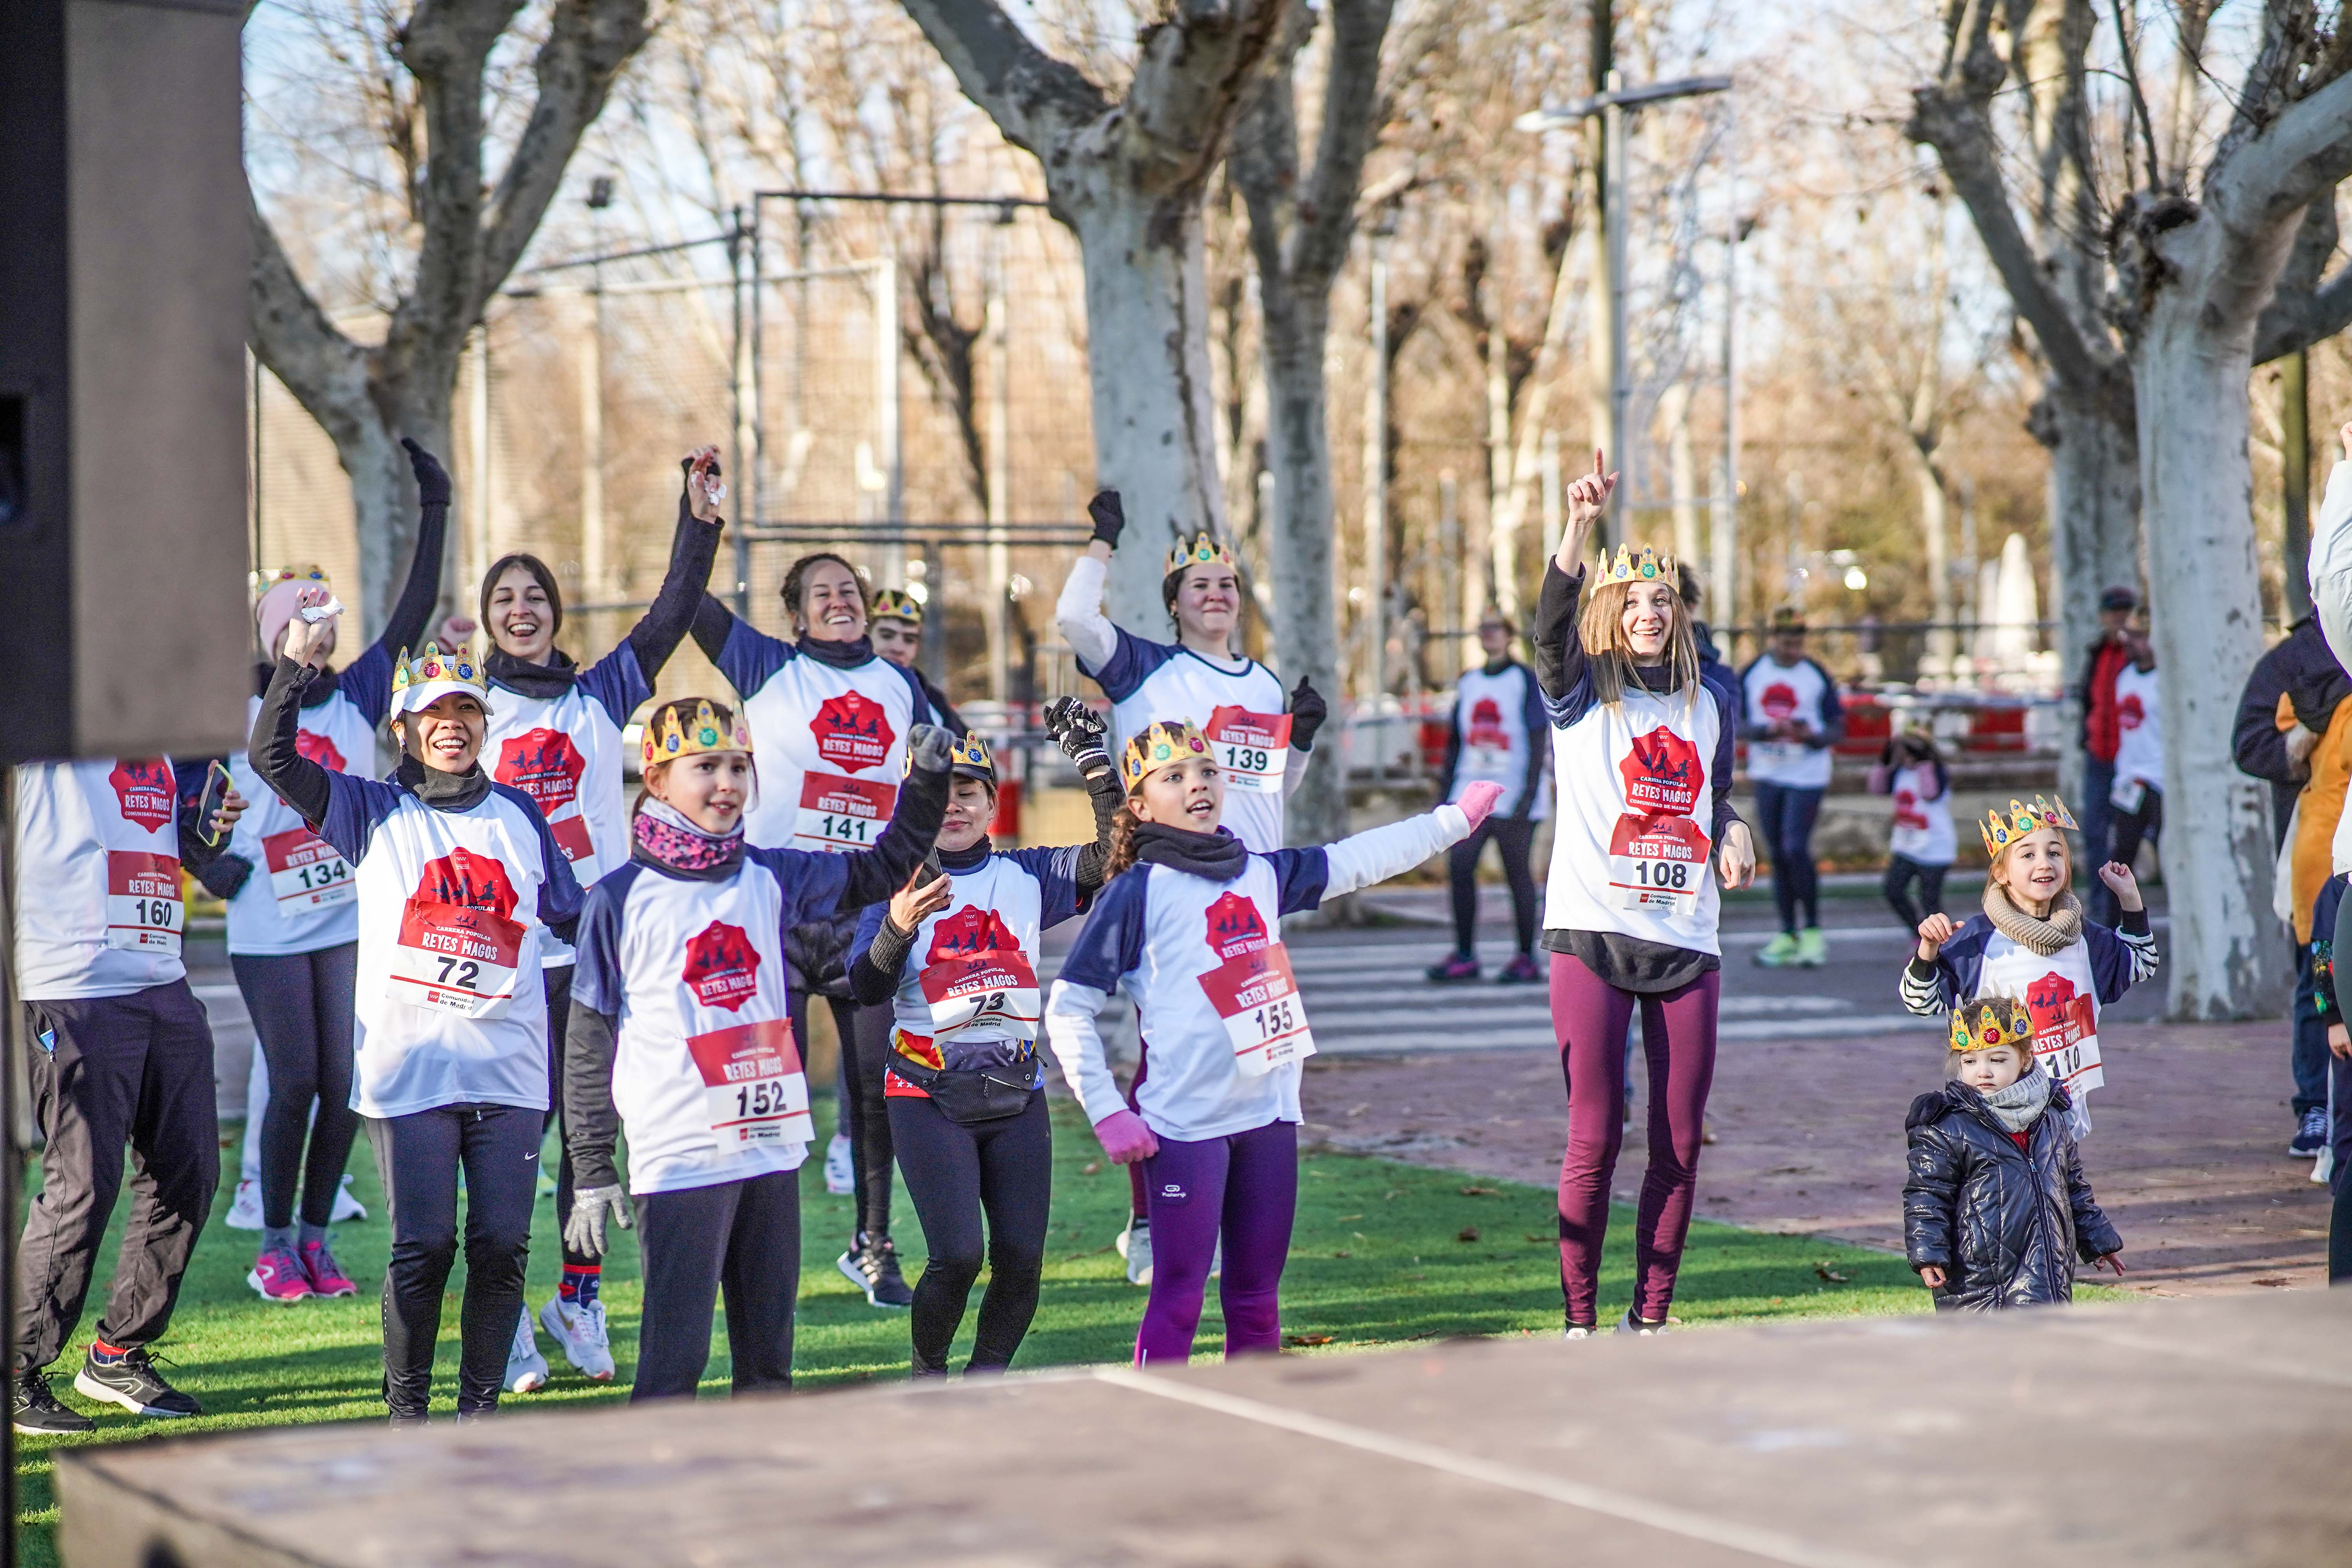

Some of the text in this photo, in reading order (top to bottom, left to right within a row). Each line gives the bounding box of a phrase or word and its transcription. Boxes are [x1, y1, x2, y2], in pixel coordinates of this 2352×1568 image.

[1227, 747, 1267, 771] 139
[515, 773, 542, 782] CARRERA
[543, 778, 573, 795] MAGOS
[125, 795, 170, 811] REYES MAGOS
[1630, 799, 1662, 808] COMUNIDAD
[1632, 783, 1692, 804] REYES MAGOS
[823, 815, 866, 841] 141
[1628, 841, 1692, 859] REYES MAGOS
[299, 859, 346, 888] 134
[1636, 861, 1686, 888] 108
[129, 879, 175, 897] REYES MAGOS
[136, 899, 172, 927] 160
[436, 926, 491, 942] CARRERA POPULAR
[422, 932, 497, 960] REYES MAGOS
[437, 956, 479, 989] 72
[955, 973, 980, 983] CARRERA
[699, 980, 728, 996] REYES
[947, 975, 1018, 997] REYES MAGOS
[1235, 985, 1267, 1008] REYES
[441, 993, 474, 1004] Comunidad
[969, 991, 1005, 1018] 73
[1256, 1000, 1292, 1038] 155
[2039, 1024, 2063, 1035] CARRERA
[2032, 1025, 2080, 1053] REYES MAGOS
[722, 1061, 757, 1081] REYES
[2045, 1045, 2080, 1078] 110
[737, 1081, 787, 1116] 152
